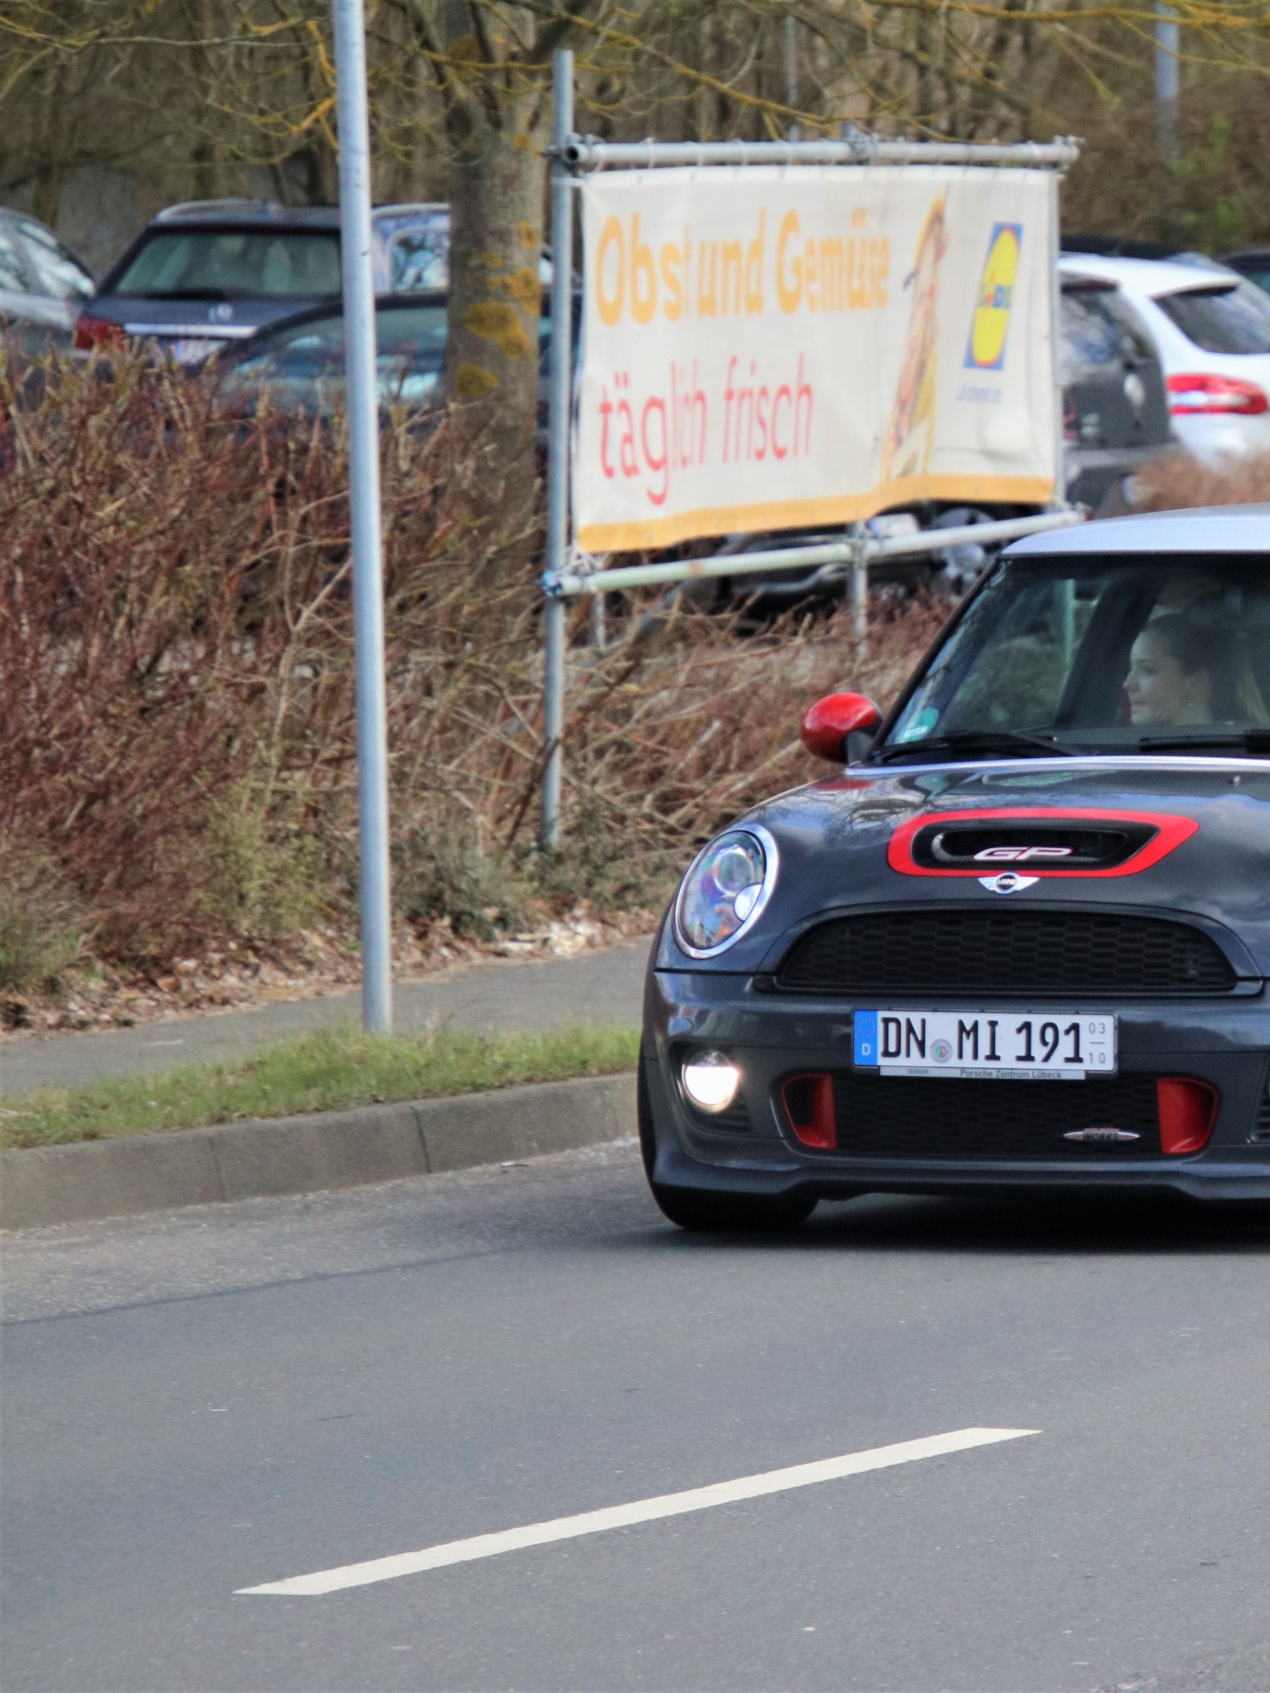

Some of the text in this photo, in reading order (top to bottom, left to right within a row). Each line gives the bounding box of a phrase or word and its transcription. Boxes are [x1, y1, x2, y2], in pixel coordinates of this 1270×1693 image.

[595, 206, 892, 327] Obst und Gemüse
[598, 351, 813, 506] täglich frisch
[973, 847, 1073, 861] GP
[1089, 1022, 1106, 1034] 03
[881, 1017, 1084, 1064] DN MI 191
[861, 1043, 871, 1056] D
[1089, 1052, 1106, 1064] 10
[960, 1068, 1062, 1080] Porsche Zentrum Lübeck
